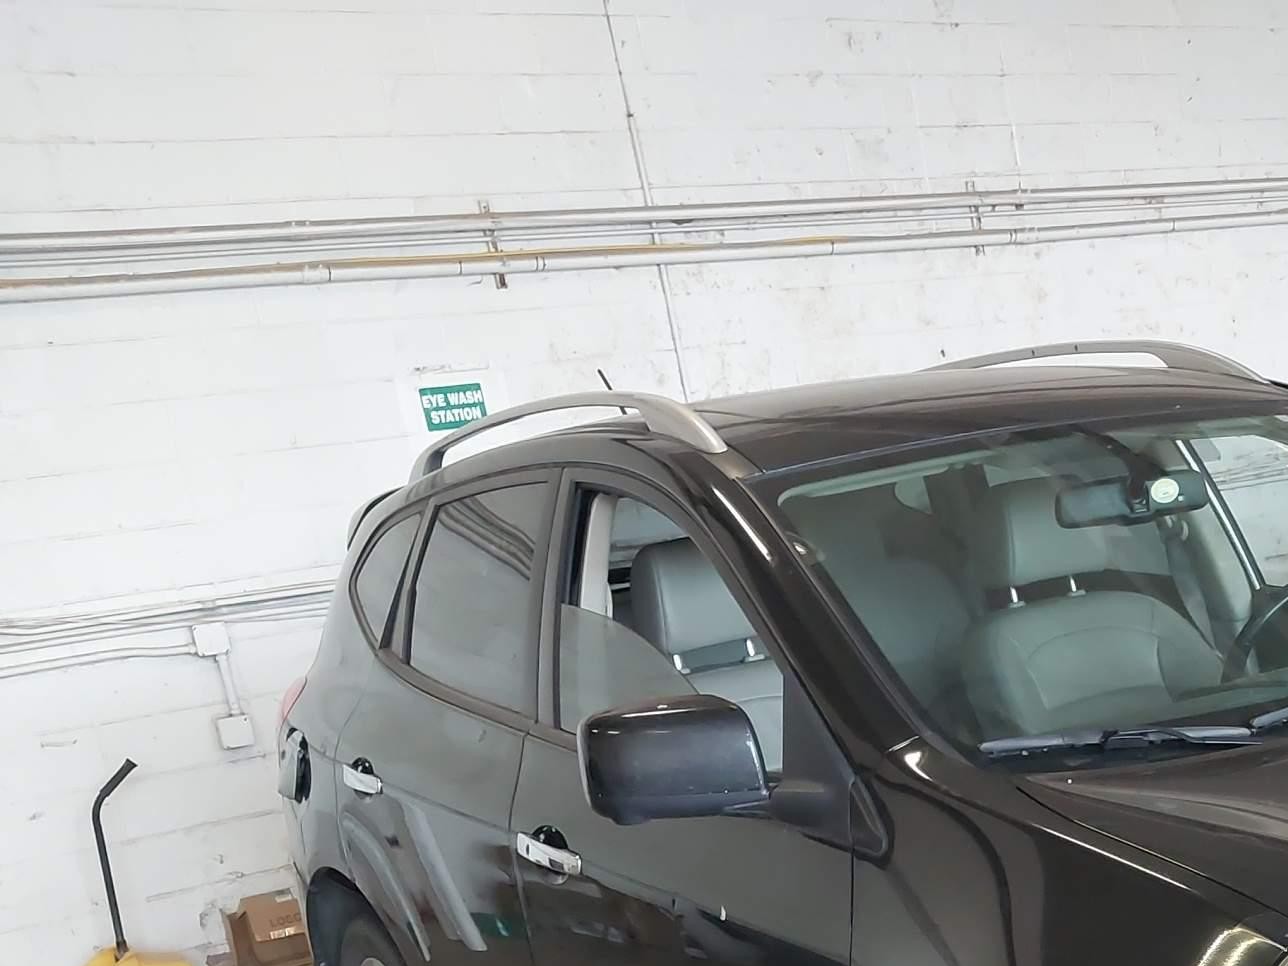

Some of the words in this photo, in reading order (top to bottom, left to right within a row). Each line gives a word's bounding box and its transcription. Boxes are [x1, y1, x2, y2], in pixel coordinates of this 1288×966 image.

[422, 394, 446, 409] EYE
[447, 390, 483, 405] WASH
[431, 406, 482, 424] STATION
